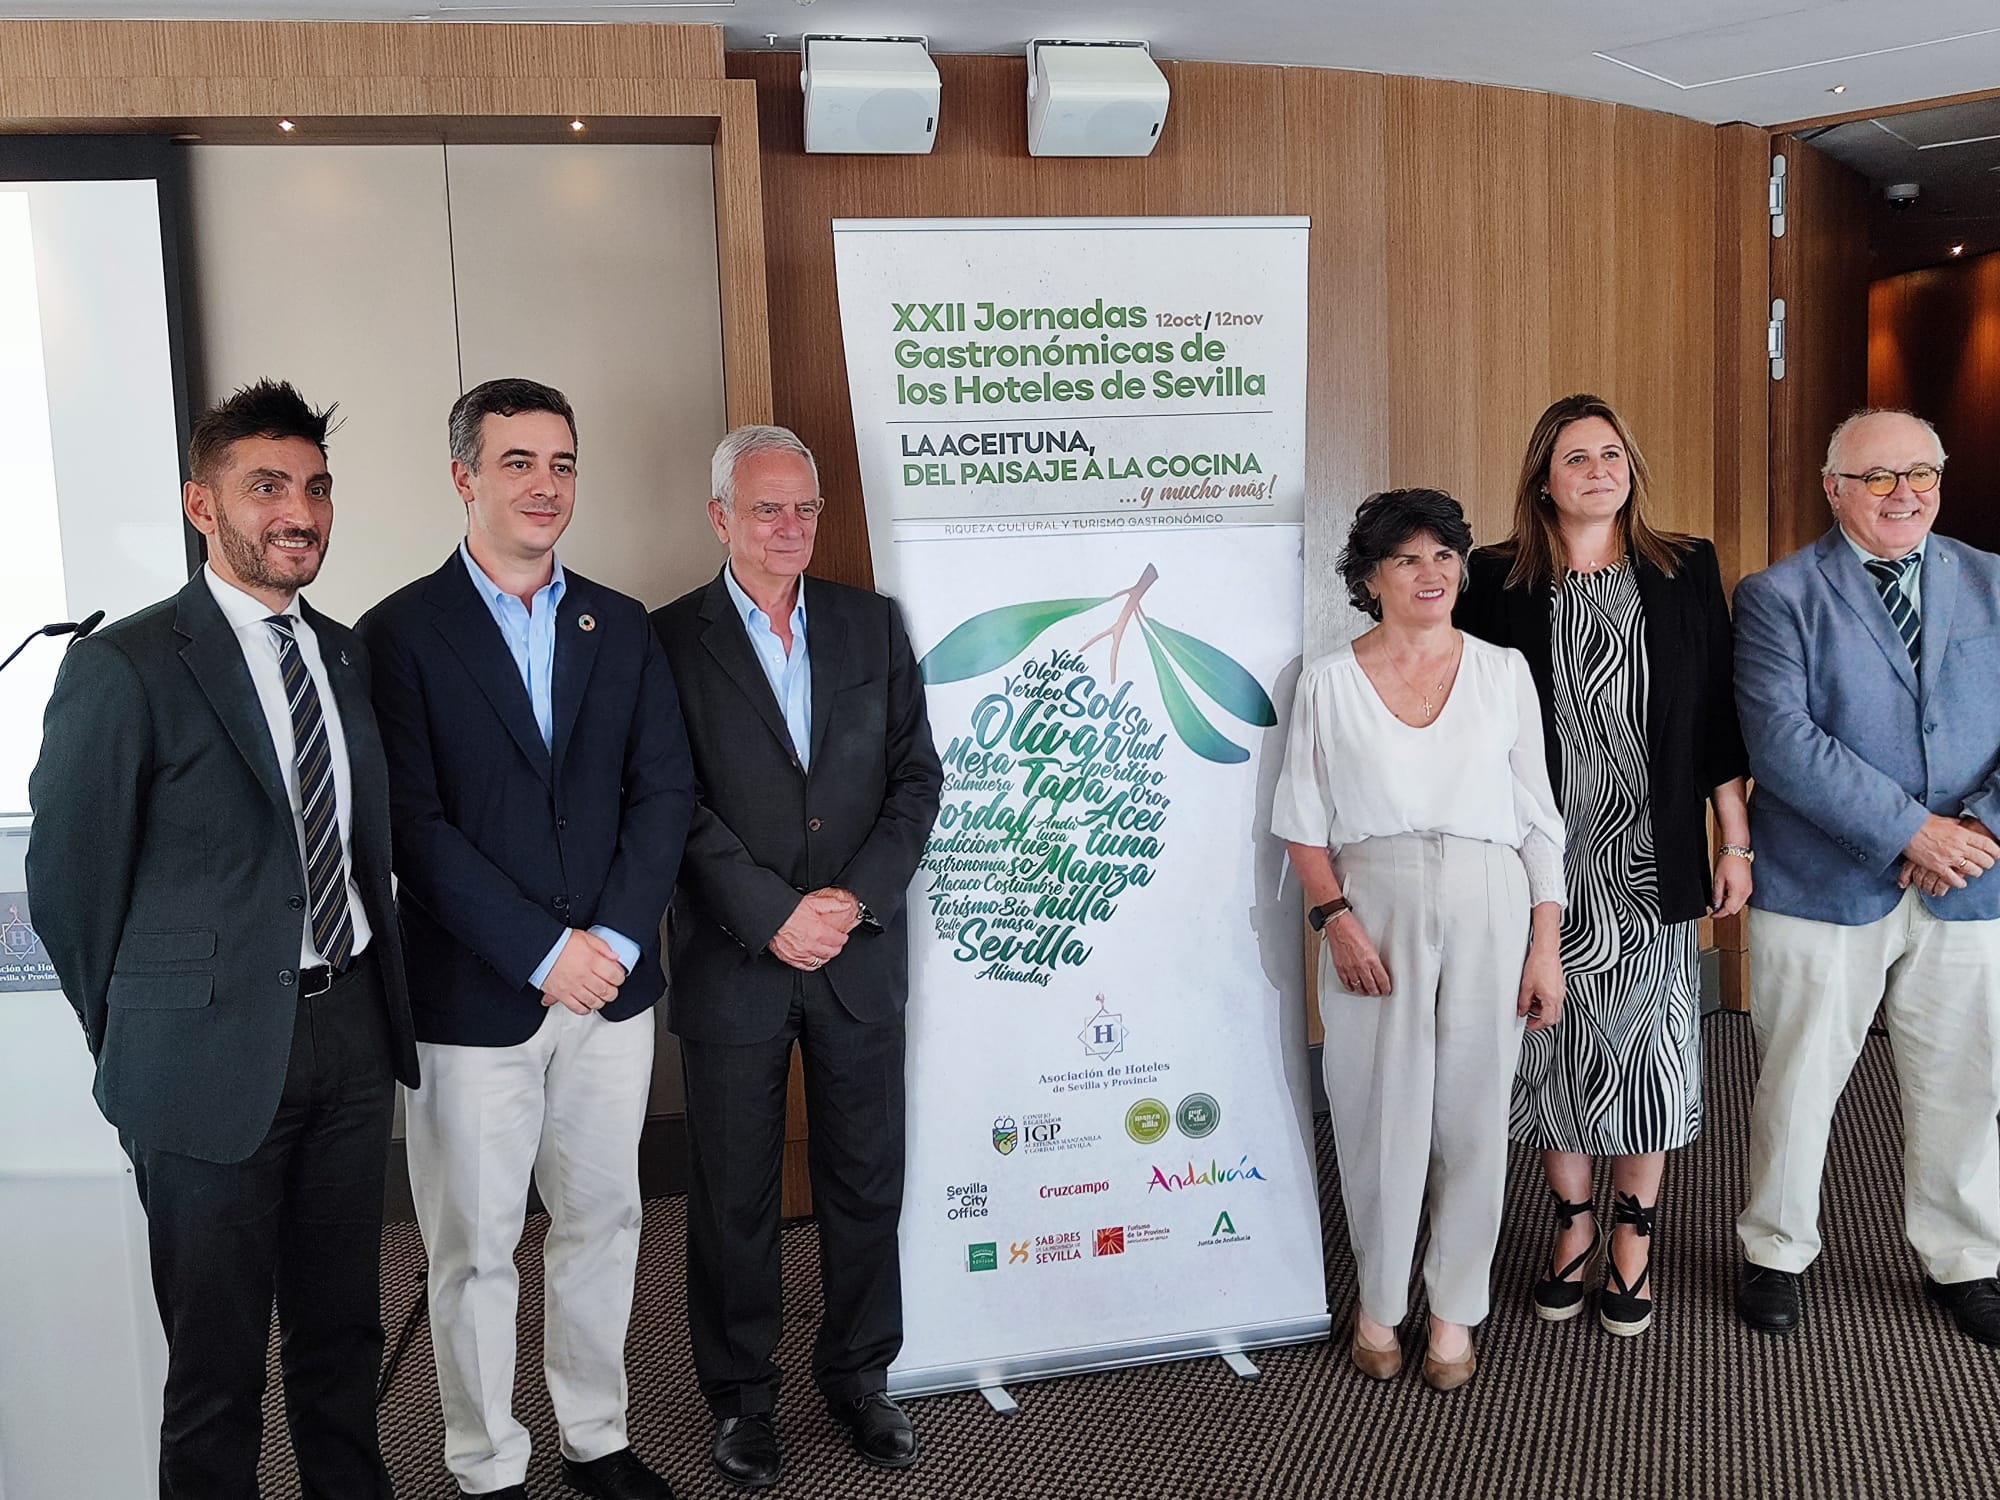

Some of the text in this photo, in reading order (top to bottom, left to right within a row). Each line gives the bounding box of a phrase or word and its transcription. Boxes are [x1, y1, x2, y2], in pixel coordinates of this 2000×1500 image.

[892, 303, 965, 332] XXII
[973, 299, 1147, 330] Jornadas
[894, 332, 1225, 369] Gastronómicas de
[898, 367, 1266, 404] los Hoteles de Sevilla
[901, 430, 1096, 456] LA ACEITUNA,
[903, 453, 1263, 486] DEL PAISAJE A LA COCINA
[1159, 477, 1226, 502] mucho
[1228, 474, 1278, 500] más!
[944, 513, 1224, 535] RIQUEZA CULTURAL Y TURISMO GASTRONÓMICO
[1051, 648, 1090, 674] Vida
[1004, 674, 1066, 701] Verdeo
[1059, 675, 1135, 721] Sol
[971, 693, 1132, 764] Olivar
[1122, 706, 1153, 736] Sa
[942, 736, 1017, 780] Mesa
[1126, 734, 1168, 761] lud
[943, 772, 1015, 792] Salmuera
[1064, 758, 1168, 790] Aperitivo
[1018, 757, 1112, 818] Tapa
[1129, 783, 1166, 806] Oro
[939, 792, 1037, 832] ordal
[1033, 814, 1078, 831] Anda
[1076, 790, 1170, 833] Acei
[999, 826, 1052, 857] Hue
[1085, 822, 1166, 860] tuna
[1006, 856, 1039, 877] so
[1022, 843, 1156, 898] Manza
[925, 872, 982, 893] Macaco
[983, 872, 1064, 895] Costumbre
[927, 893, 1001, 918] Turismo
[999, 896, 1032, 917] Bio
[1033, 884, 1119, 925] nilla
[991, 917, 1038, 932] masa
[10, 930, 27, 946] H
[953, 917, 1093, 970] Sevilla
[23, 964, 36, 972] de
[1093, 1024, 1114, 1044] H
[1038, 1062, 1170, 1085] Asociación de Hoteles
[1052, 1075, 1158, 1094] de Sevilla y Provincia
[1024, 1123, 1061, 1143] IGP
[1146, 1155, 1267, 1194] Andalucía
[946, 1182, 988, 1198] Sevilla
[960, 1195, 988, 1208] City
[1039, 1180, 1110, 1199] Cruzcampo
[947, 1206, 989, 1220] Office
[1035, 1231, 1081, 1247] SABORES
[1036, 1249, 1082, 1265] SEVILLA
